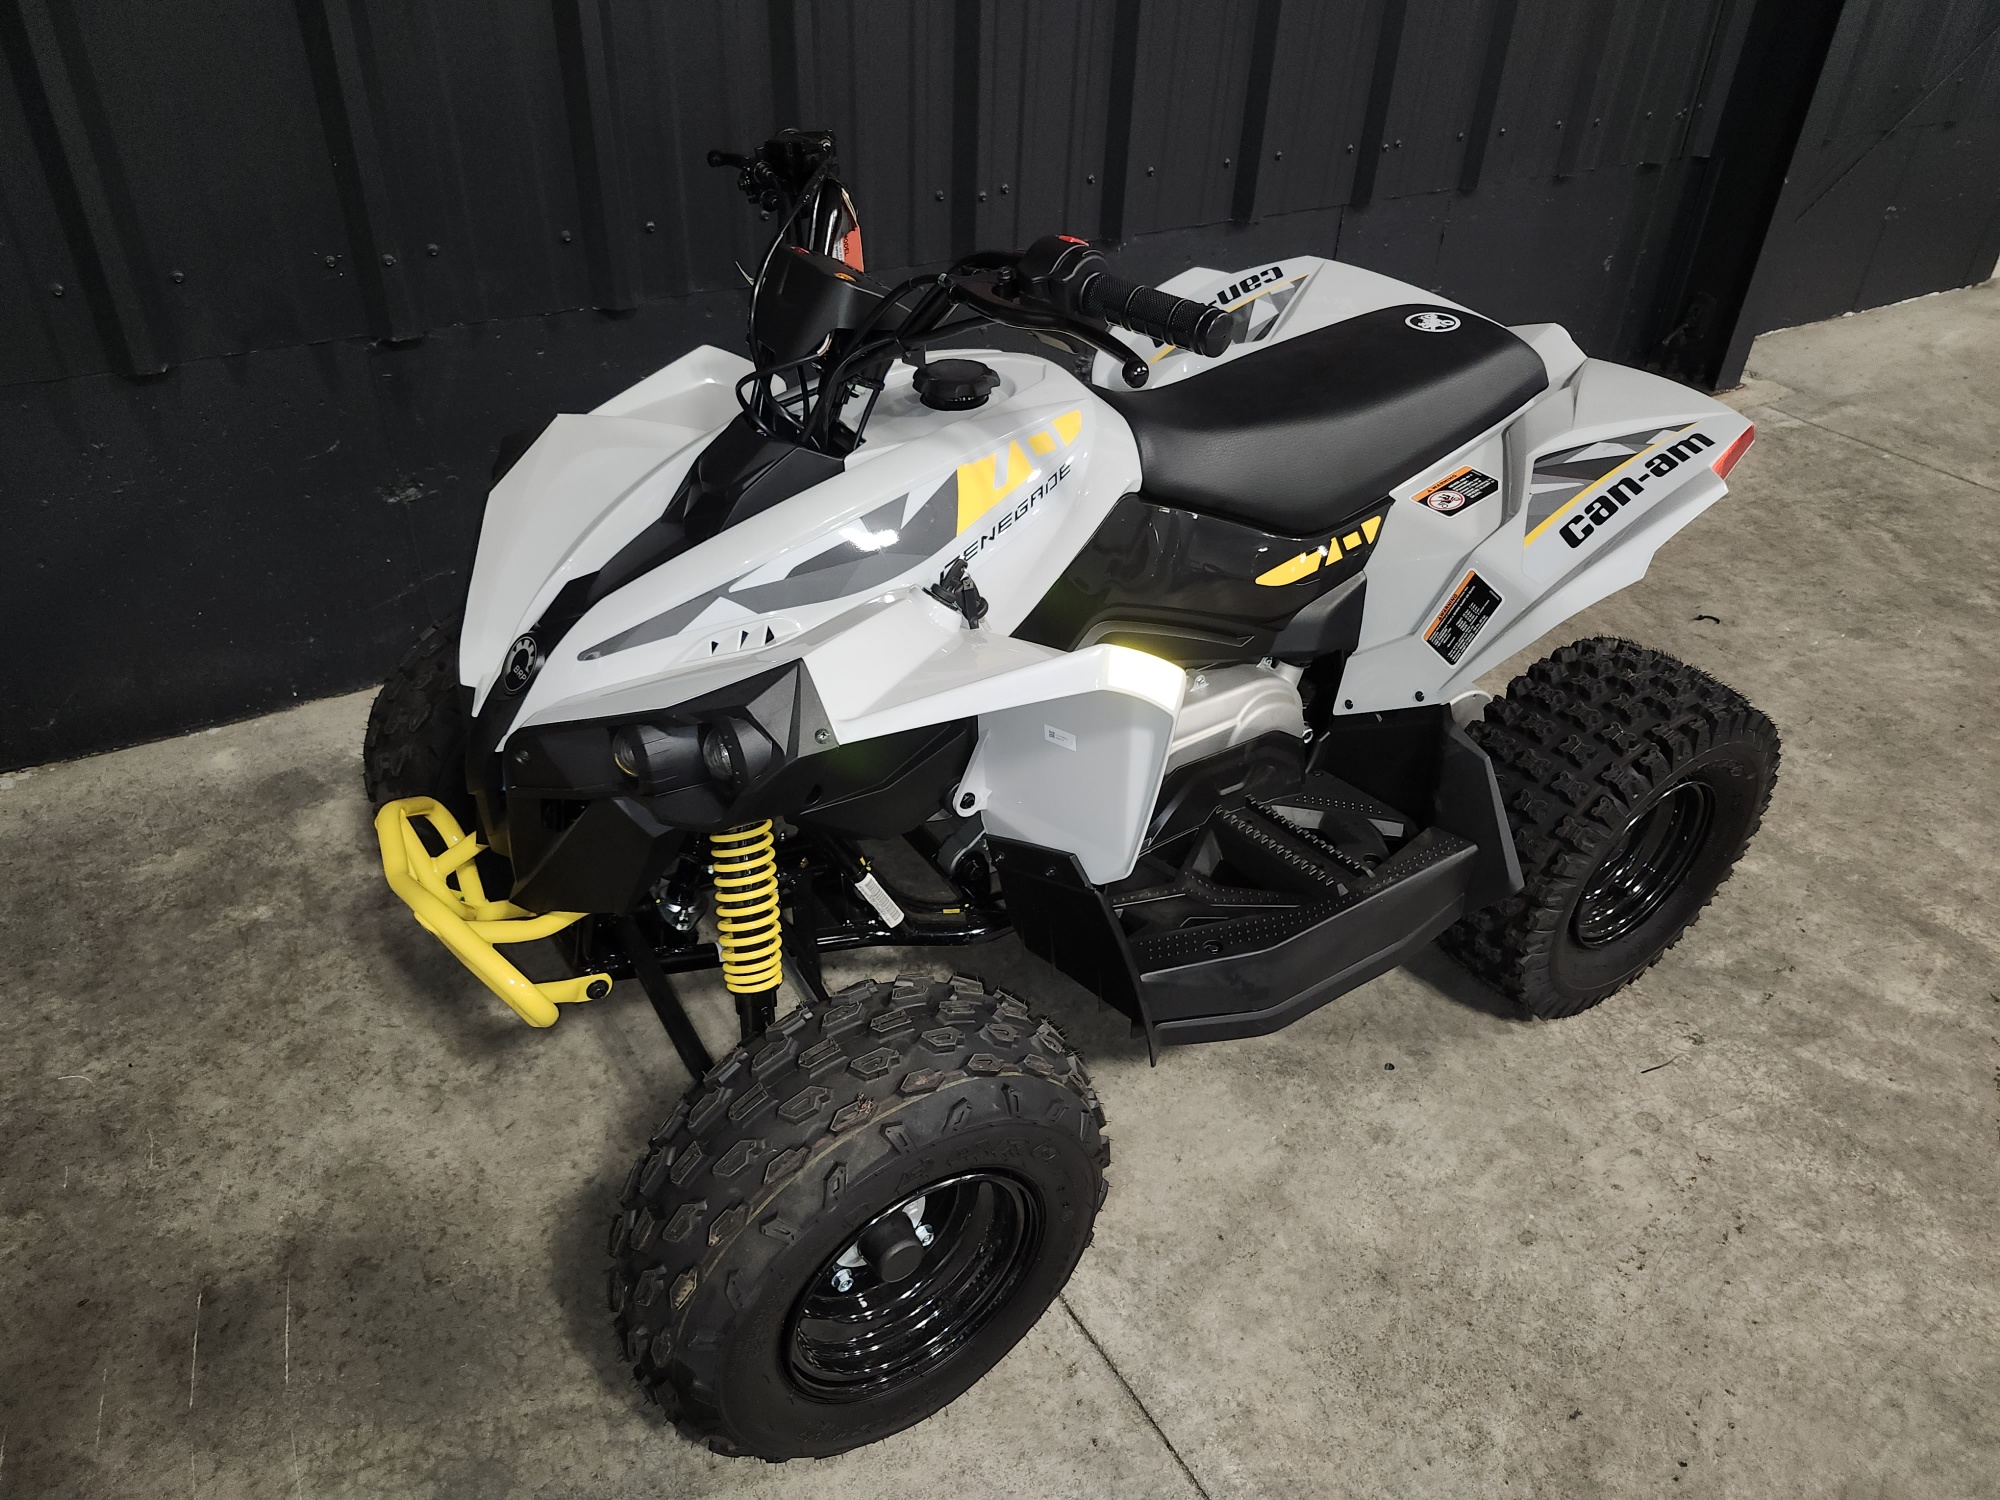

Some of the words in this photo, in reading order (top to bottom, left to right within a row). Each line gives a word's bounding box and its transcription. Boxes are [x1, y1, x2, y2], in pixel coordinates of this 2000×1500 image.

[1432, 474, 1457, 490] WARNING
[1559, 432, 1716, 548] can-am
[1440, 594, 1457, 617] WARNING
[513, 665, 527, 681] BRP
